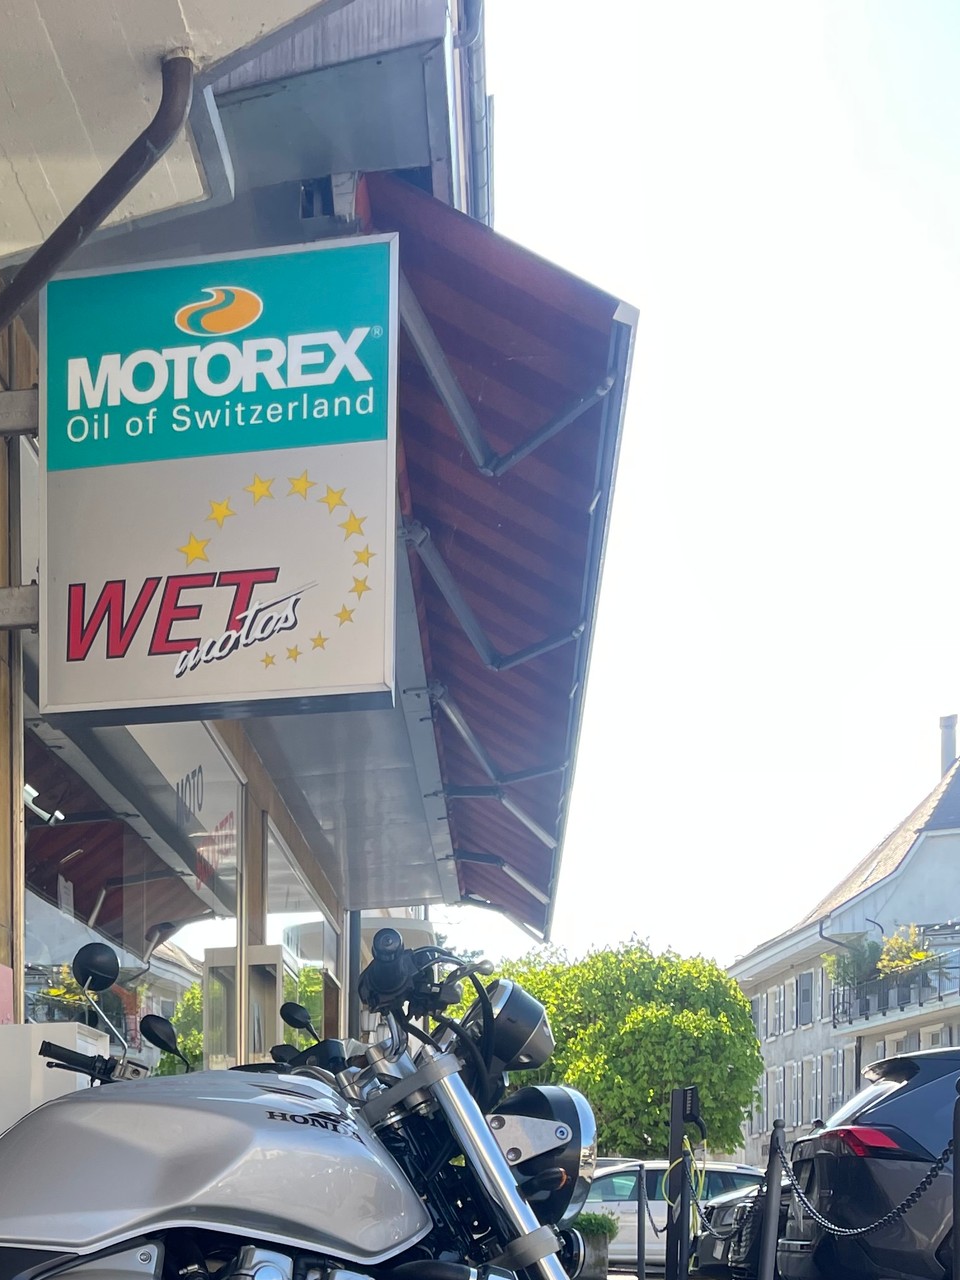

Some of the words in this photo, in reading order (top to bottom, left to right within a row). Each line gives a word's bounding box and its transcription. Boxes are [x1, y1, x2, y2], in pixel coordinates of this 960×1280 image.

[67, 327, 374, 410] MOTOREX
[66, 413, 109, 442] Oil
[126, 407, 157, 436] of
[172, 387, 374, 432] Switzerland
[66, 567, 280, 662] WET
[175, 585, 310, 678] motos
